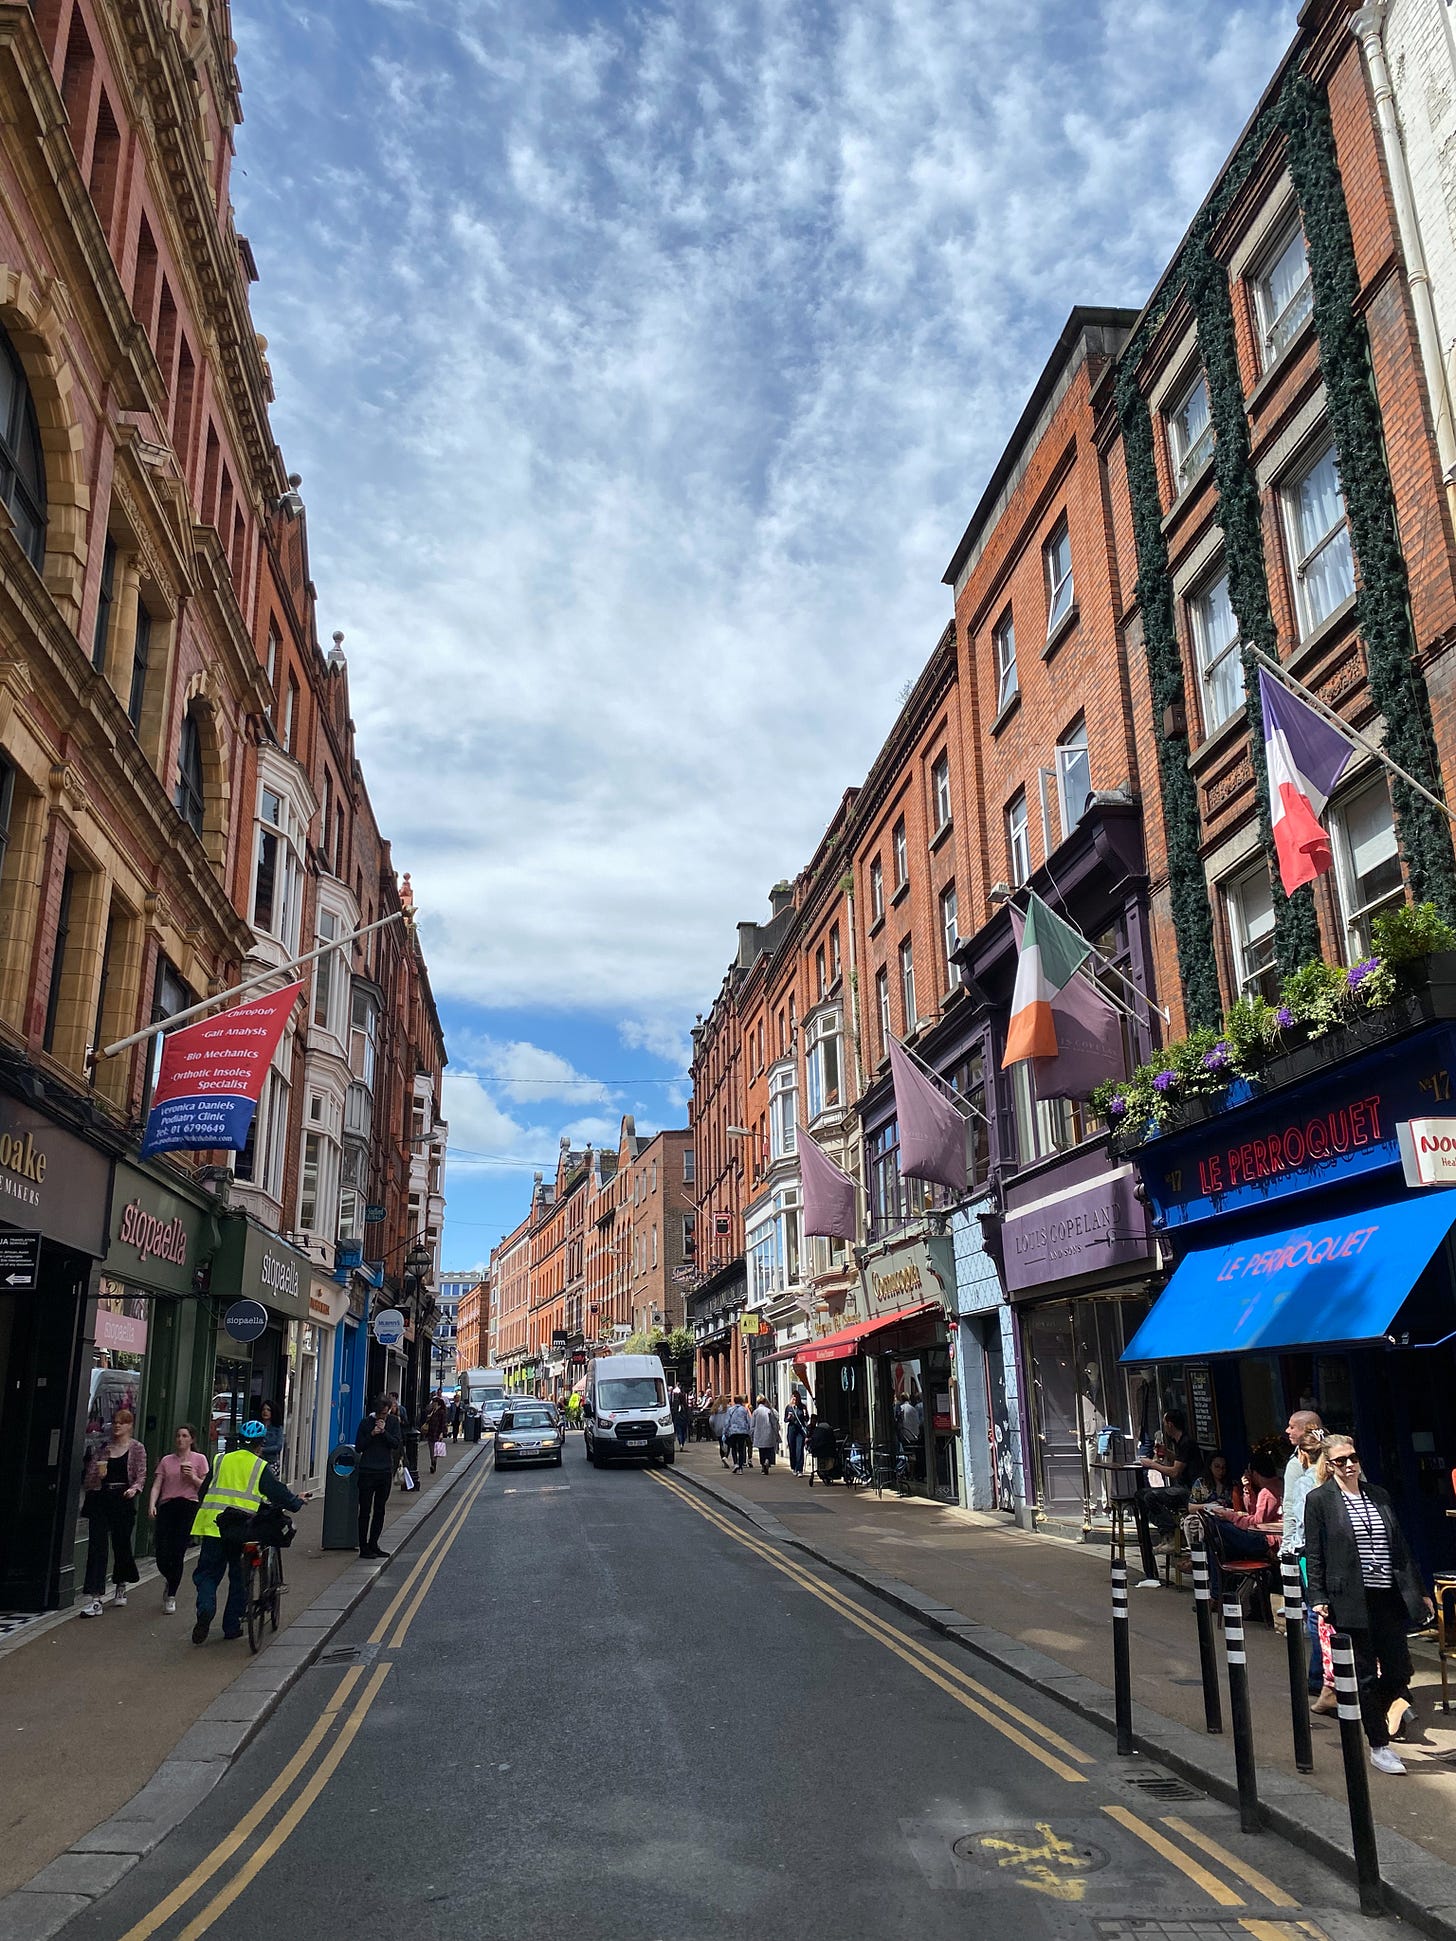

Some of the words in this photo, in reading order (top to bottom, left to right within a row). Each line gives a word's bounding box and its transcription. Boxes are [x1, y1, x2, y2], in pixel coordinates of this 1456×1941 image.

[226, 1027, 268, 1037] Analysis
[203, 1049, 260, 1059] Mechanics
[213, 1067, 252, 1078] Insoles
[197, 1080, 248, 1090] Specialist
[198, 1100, 236, 1111] Daniels
[160, 1113, 197, 1126] Podiatry
[198, 1111, 226, 1121] Clinic
[170, 1124, 180, 1134] 01
[183, 1123, 225, 1133] 6799649
[1199, 1153, 1222, 1195] LE
[1228, 1095, 1385, 1186] PERROQUET
[120, 1197, 187, 1266] siopaella
[1015, 1226, 1048, 1255] LOUIS
[1050, 1202, 1122, 1244] COPELAND
[1048, 1250, 1063, 1262] AND
[1064, 1244, 1083, 1256] SONS
[1216, 1256, 1244, 1282] LE
[1241, 1225, 1380, 1279] PERROQUET
[261, 1249, 299, 1298] siopaella
[226, 1315, 265, 1326] siopaella
[104, 1319, 135, 1345] siopaella
